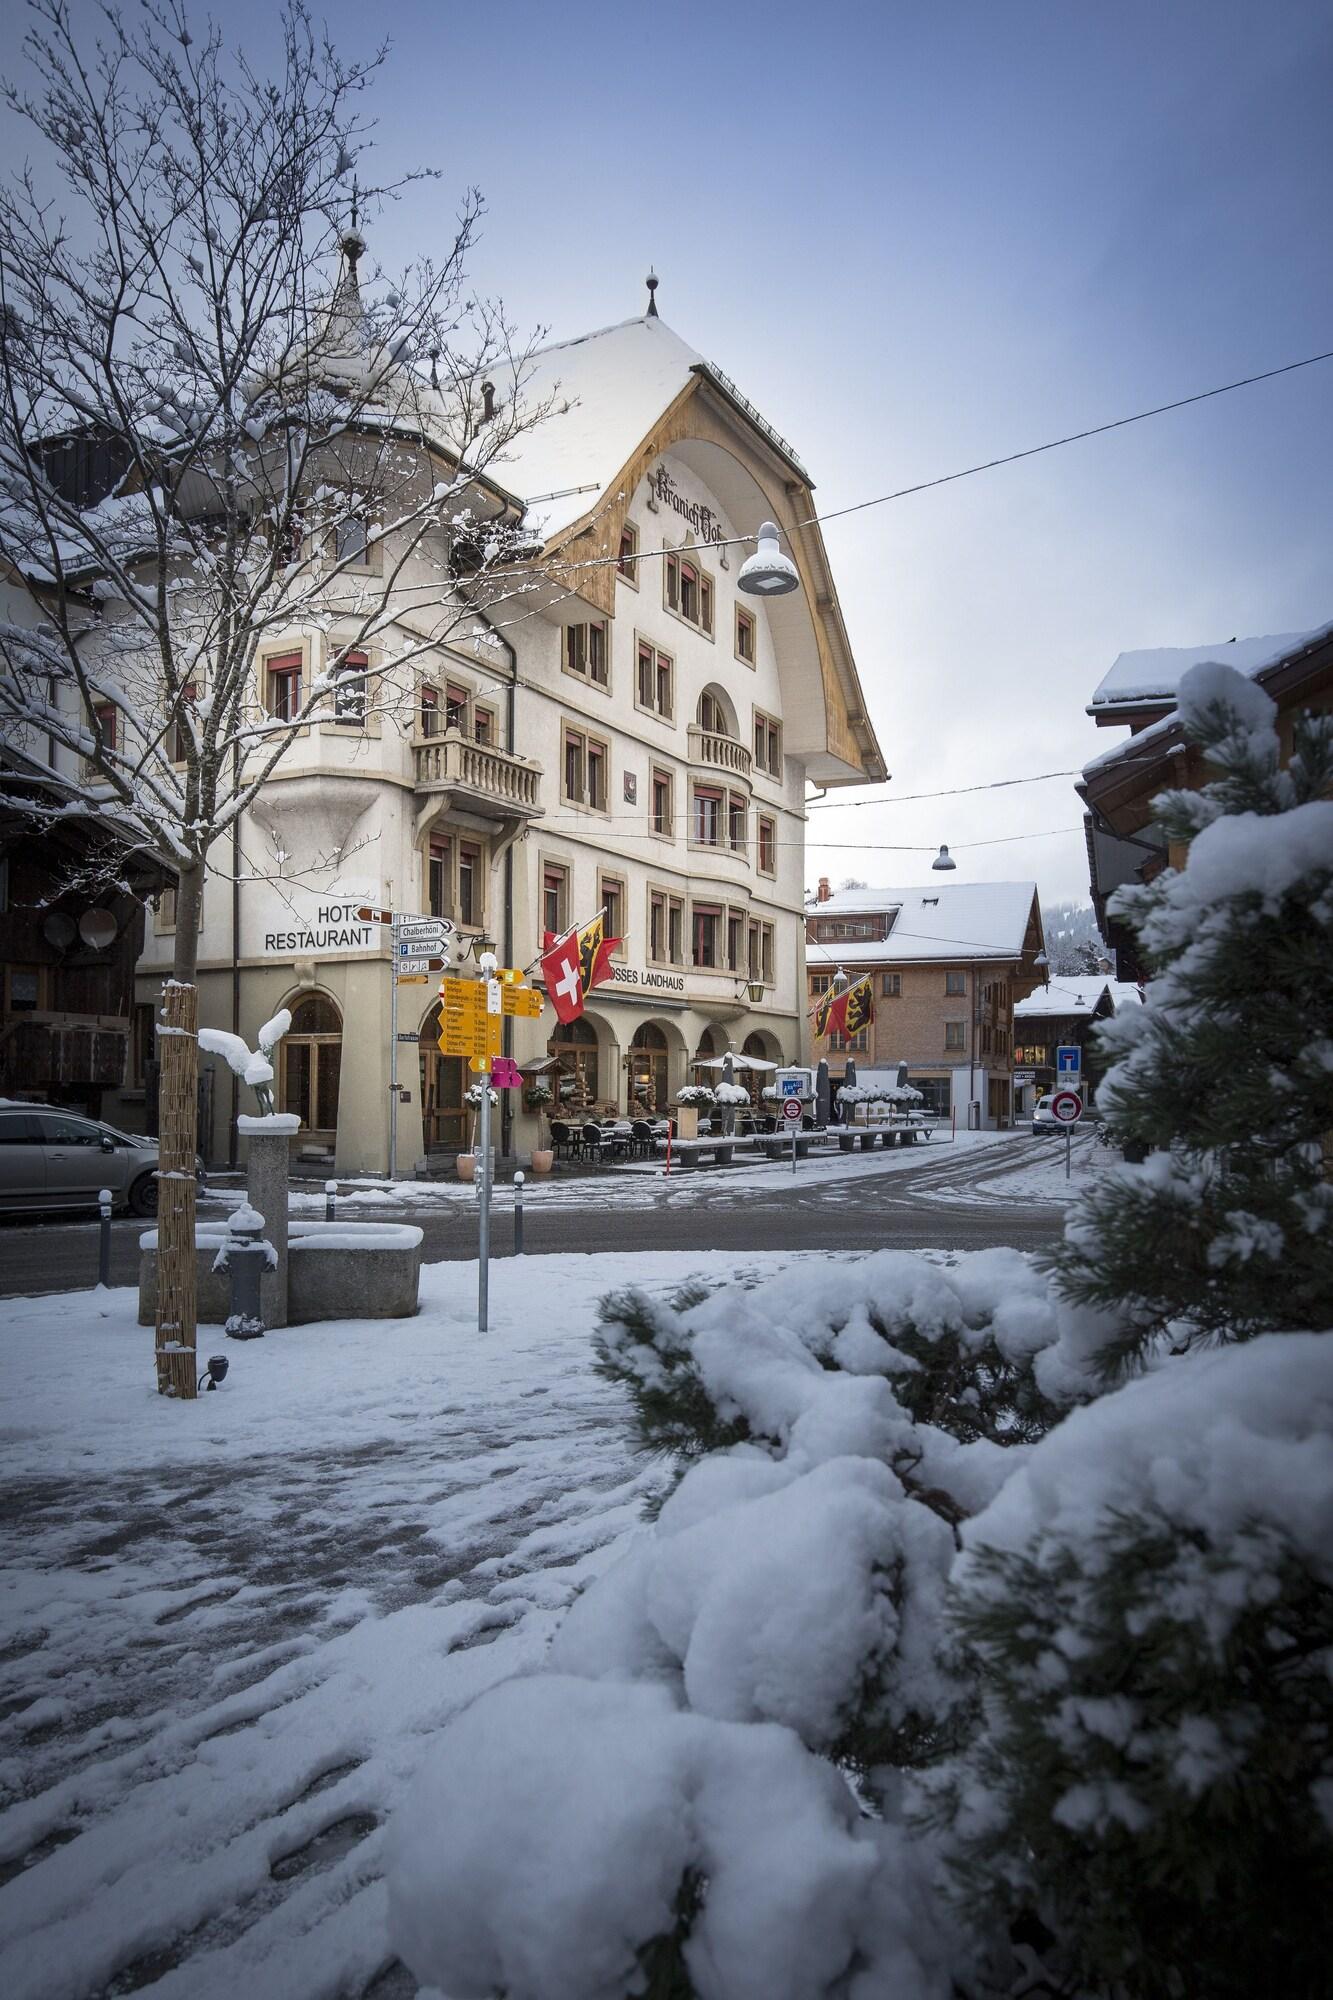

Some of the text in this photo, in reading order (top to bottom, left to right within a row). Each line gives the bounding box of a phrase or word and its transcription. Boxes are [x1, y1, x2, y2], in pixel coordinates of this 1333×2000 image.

[318, 904, 360, 923] HOT
[265, 927, 372, 950] RESTAURANT
[403, 924, 439, 937] Chalberhöni
[411, 942, 437, 953] Bahnhof
[610, 967, 684, 990] OSSES LANDHAUS
